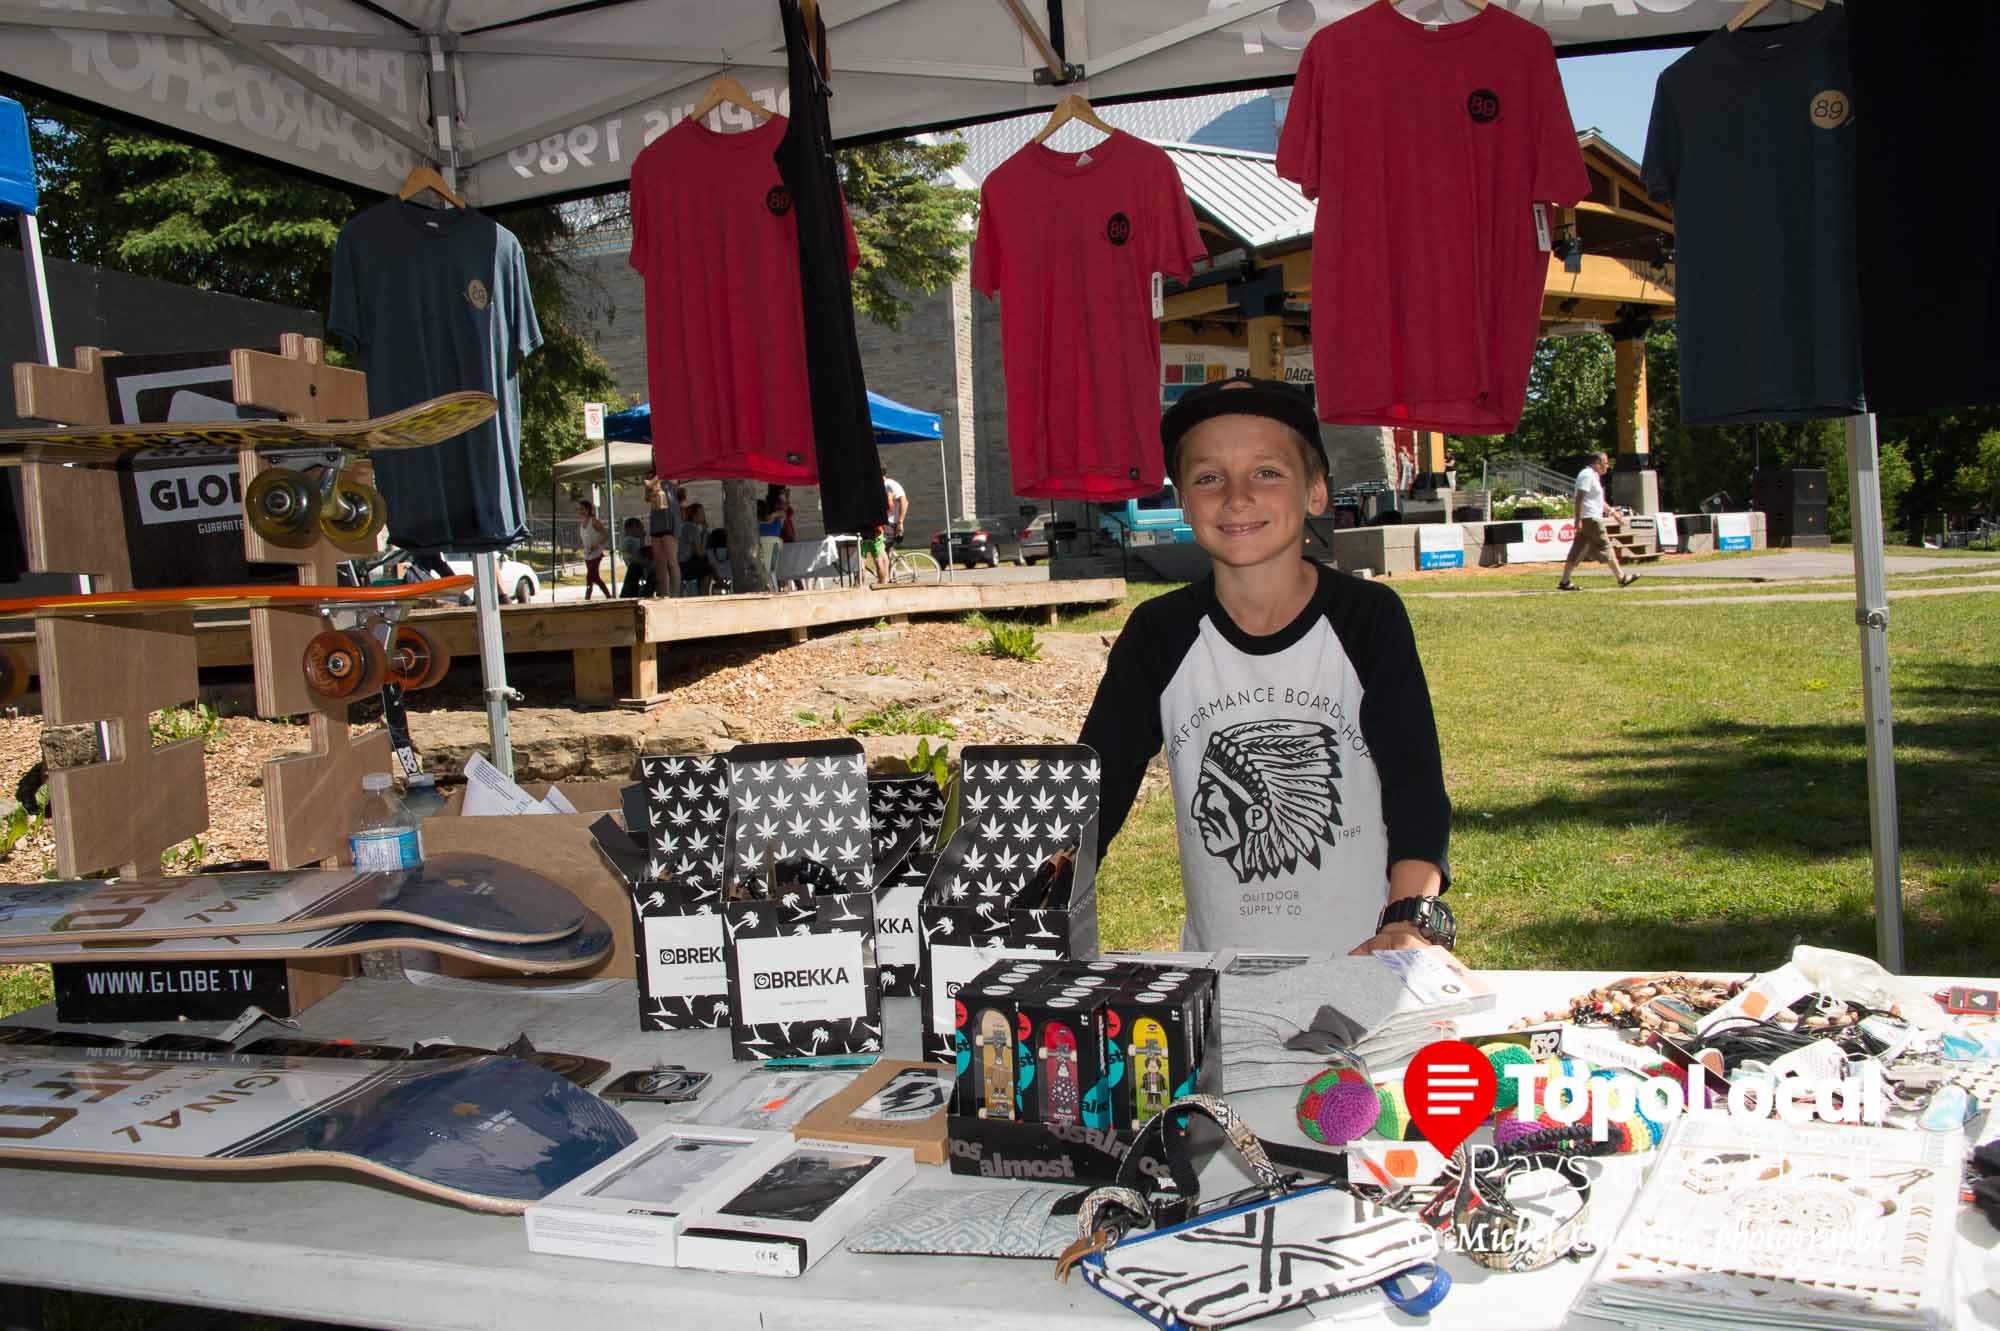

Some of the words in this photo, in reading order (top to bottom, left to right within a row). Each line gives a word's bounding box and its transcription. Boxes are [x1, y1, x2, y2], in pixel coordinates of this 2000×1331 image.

[1471, 97, 1496, 117] 89
[1814, 99, 1844, 120] 89
[1110, 220, 1128, 239] 89
[1251, 808, 1264, 828] P
[1337, 825, 1362, 841] 1989
[1241, 889, 1300, 903] OUTDOOR
[1239, 904, 1282, 916] SUPPLY
[676, 945, 727, 965] BREK
[87, 969, 254, 995] WWW.GLOBE.TV
[771, 967, 850, 989] BREKKA
[979, 1152, 1076, 1178] almost
